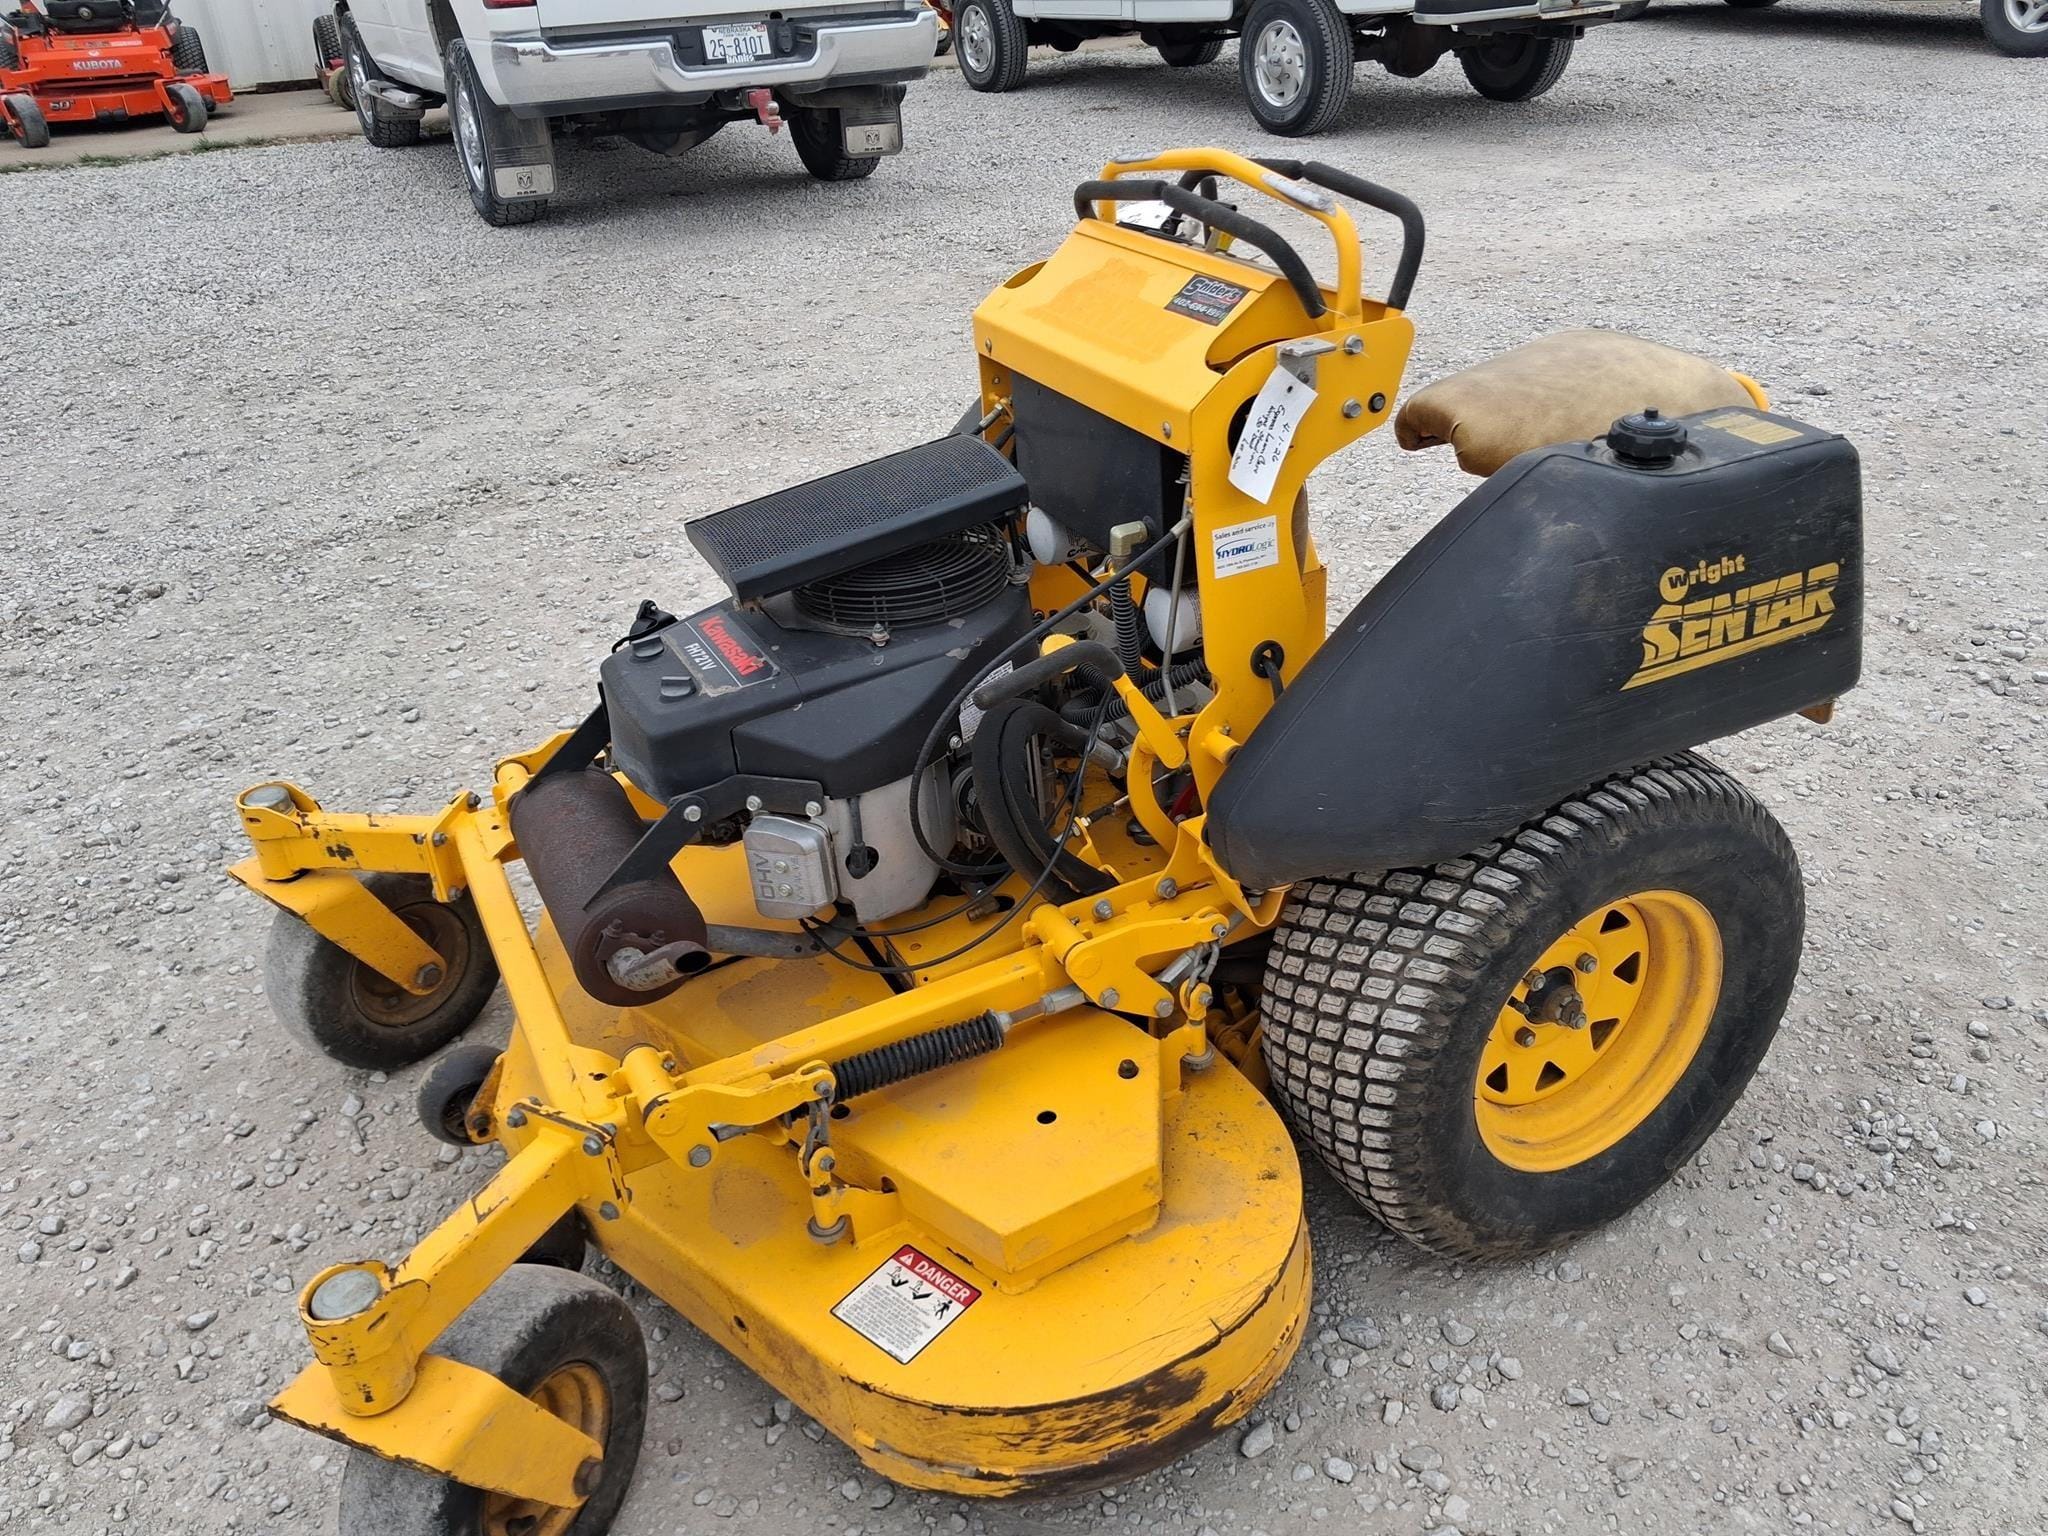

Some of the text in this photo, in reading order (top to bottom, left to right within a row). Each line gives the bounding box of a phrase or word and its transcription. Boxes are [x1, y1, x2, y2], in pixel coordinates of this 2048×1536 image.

[709, 35, 764, 58] 25-810T
[73, 59, 122, 71] KUBOTA
[1214, 532, 1231, 540] Sales
[1232, 528, 1244, 536] and
[1244, 523, 1266, 533] service
[1640, 562, 1840, 669] SENTAR
[684, 642, 717, 671] FH721V
[698, 615, 765, 676] Kawasaki
[753, 853, 776, 899] OHV
[914, 1260, 971, 1302] DANGER
